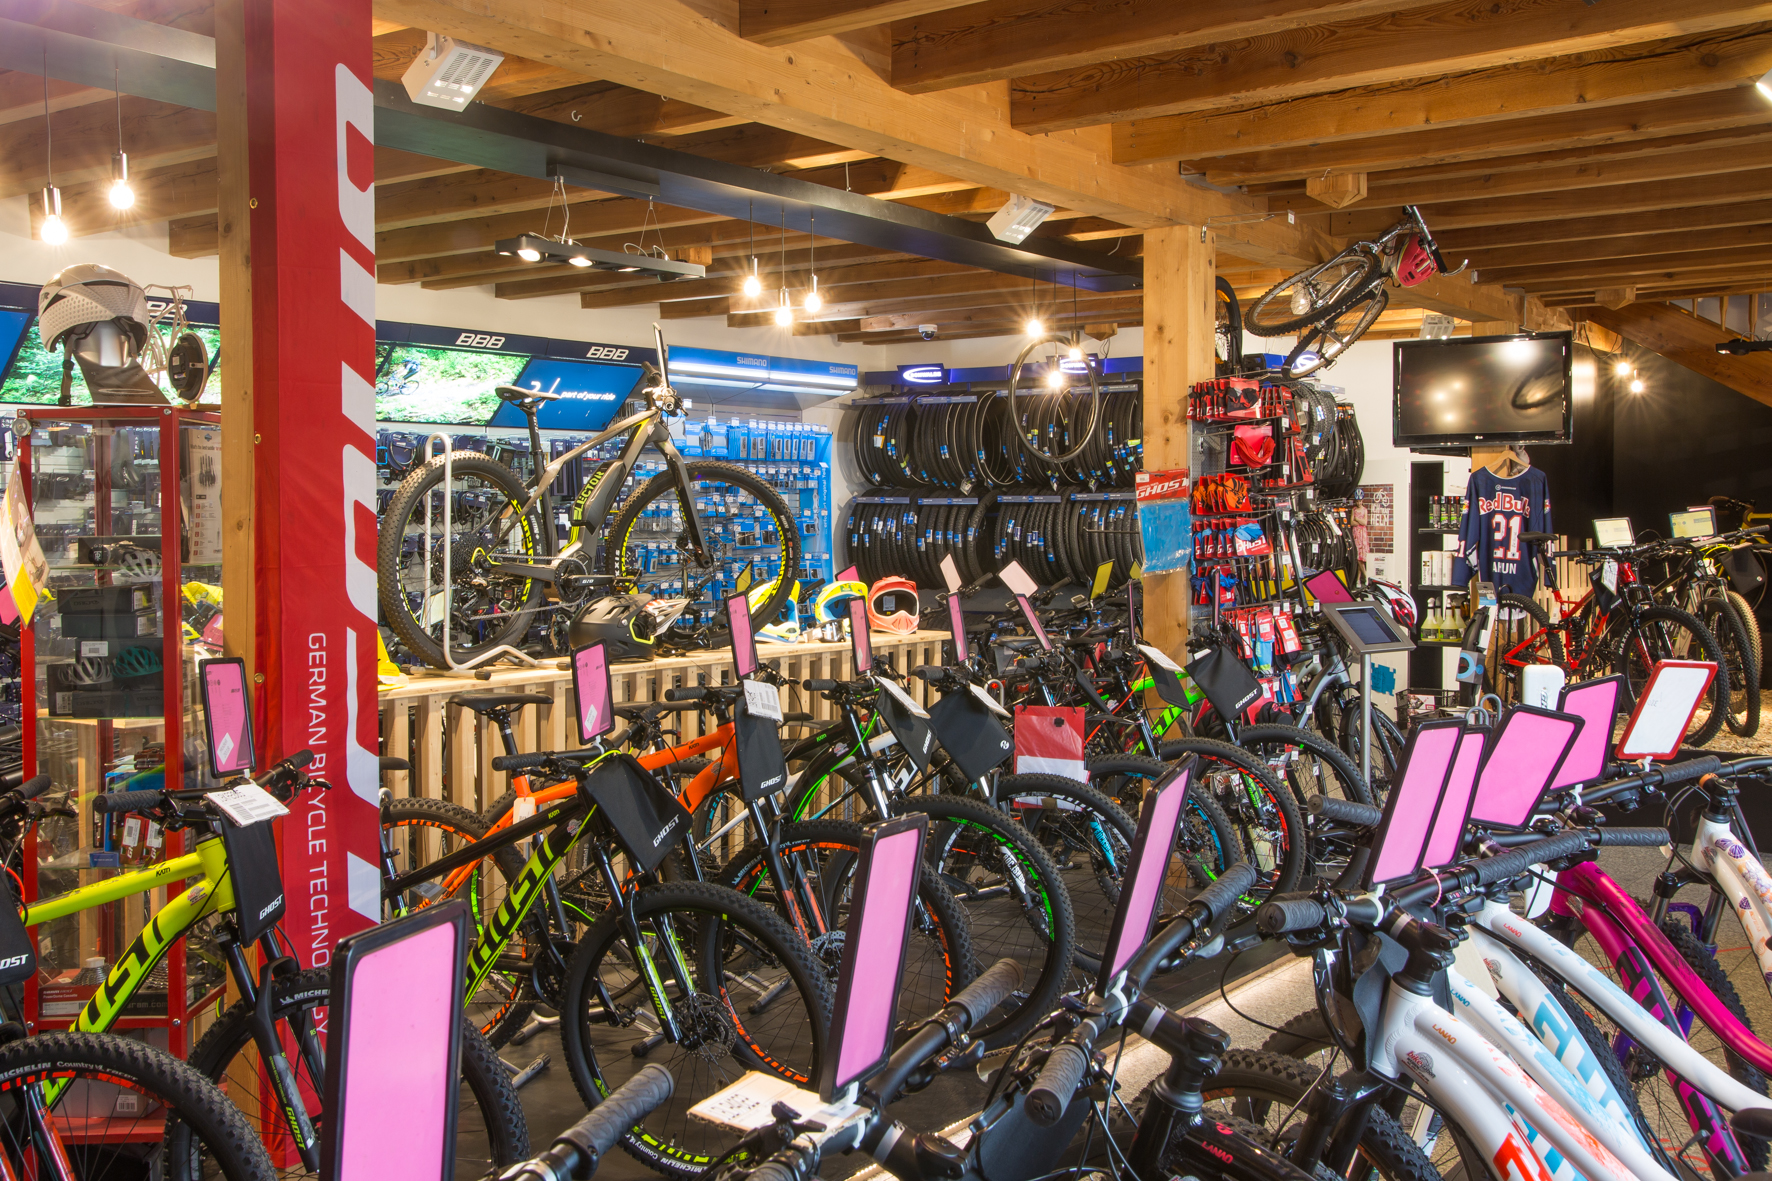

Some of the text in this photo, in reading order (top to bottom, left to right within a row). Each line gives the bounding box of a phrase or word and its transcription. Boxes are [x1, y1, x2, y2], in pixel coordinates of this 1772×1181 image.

[455, 333, 505, 349] BBB
[586, 346, 629, 361] BBB
[736, 356, 767, 367] SHIMANO
[829, 366, 856, 375] SHIMANO
[560, 391, 577, 400] part
[583, 393, 601, 401] your
[601, 392, 616, 401] ride
[1136, 477, 1190, 499] GHOST
[1371, 514, 1390, 526] HELM
[1491, 513, 1522, 560] 21
[308, 632, 327, 745] GERMAN
[1235, 687, 1258, 710] GHOST
[760, 773, 783, 790] GHOST
[652, 813, 681, 848] GHOST
[259, 893, 283, 920] GHOST
[309, 860, 330, 1034] TECHNOGY
[294, 988, 330, 1000] MICHE
[649, 986, 668, 1021] GHOST
[1431, 1023, 1457, 1046] LANAO
[0, 1061, 51, 1080] MICHELIN
[56, 1061, 94, 1071] Country
[285, 1106, 307, 1151] GHOST
[634, 1140, 659, 1160] Country
[1201, 1141, 1234, 1164] LANAO
